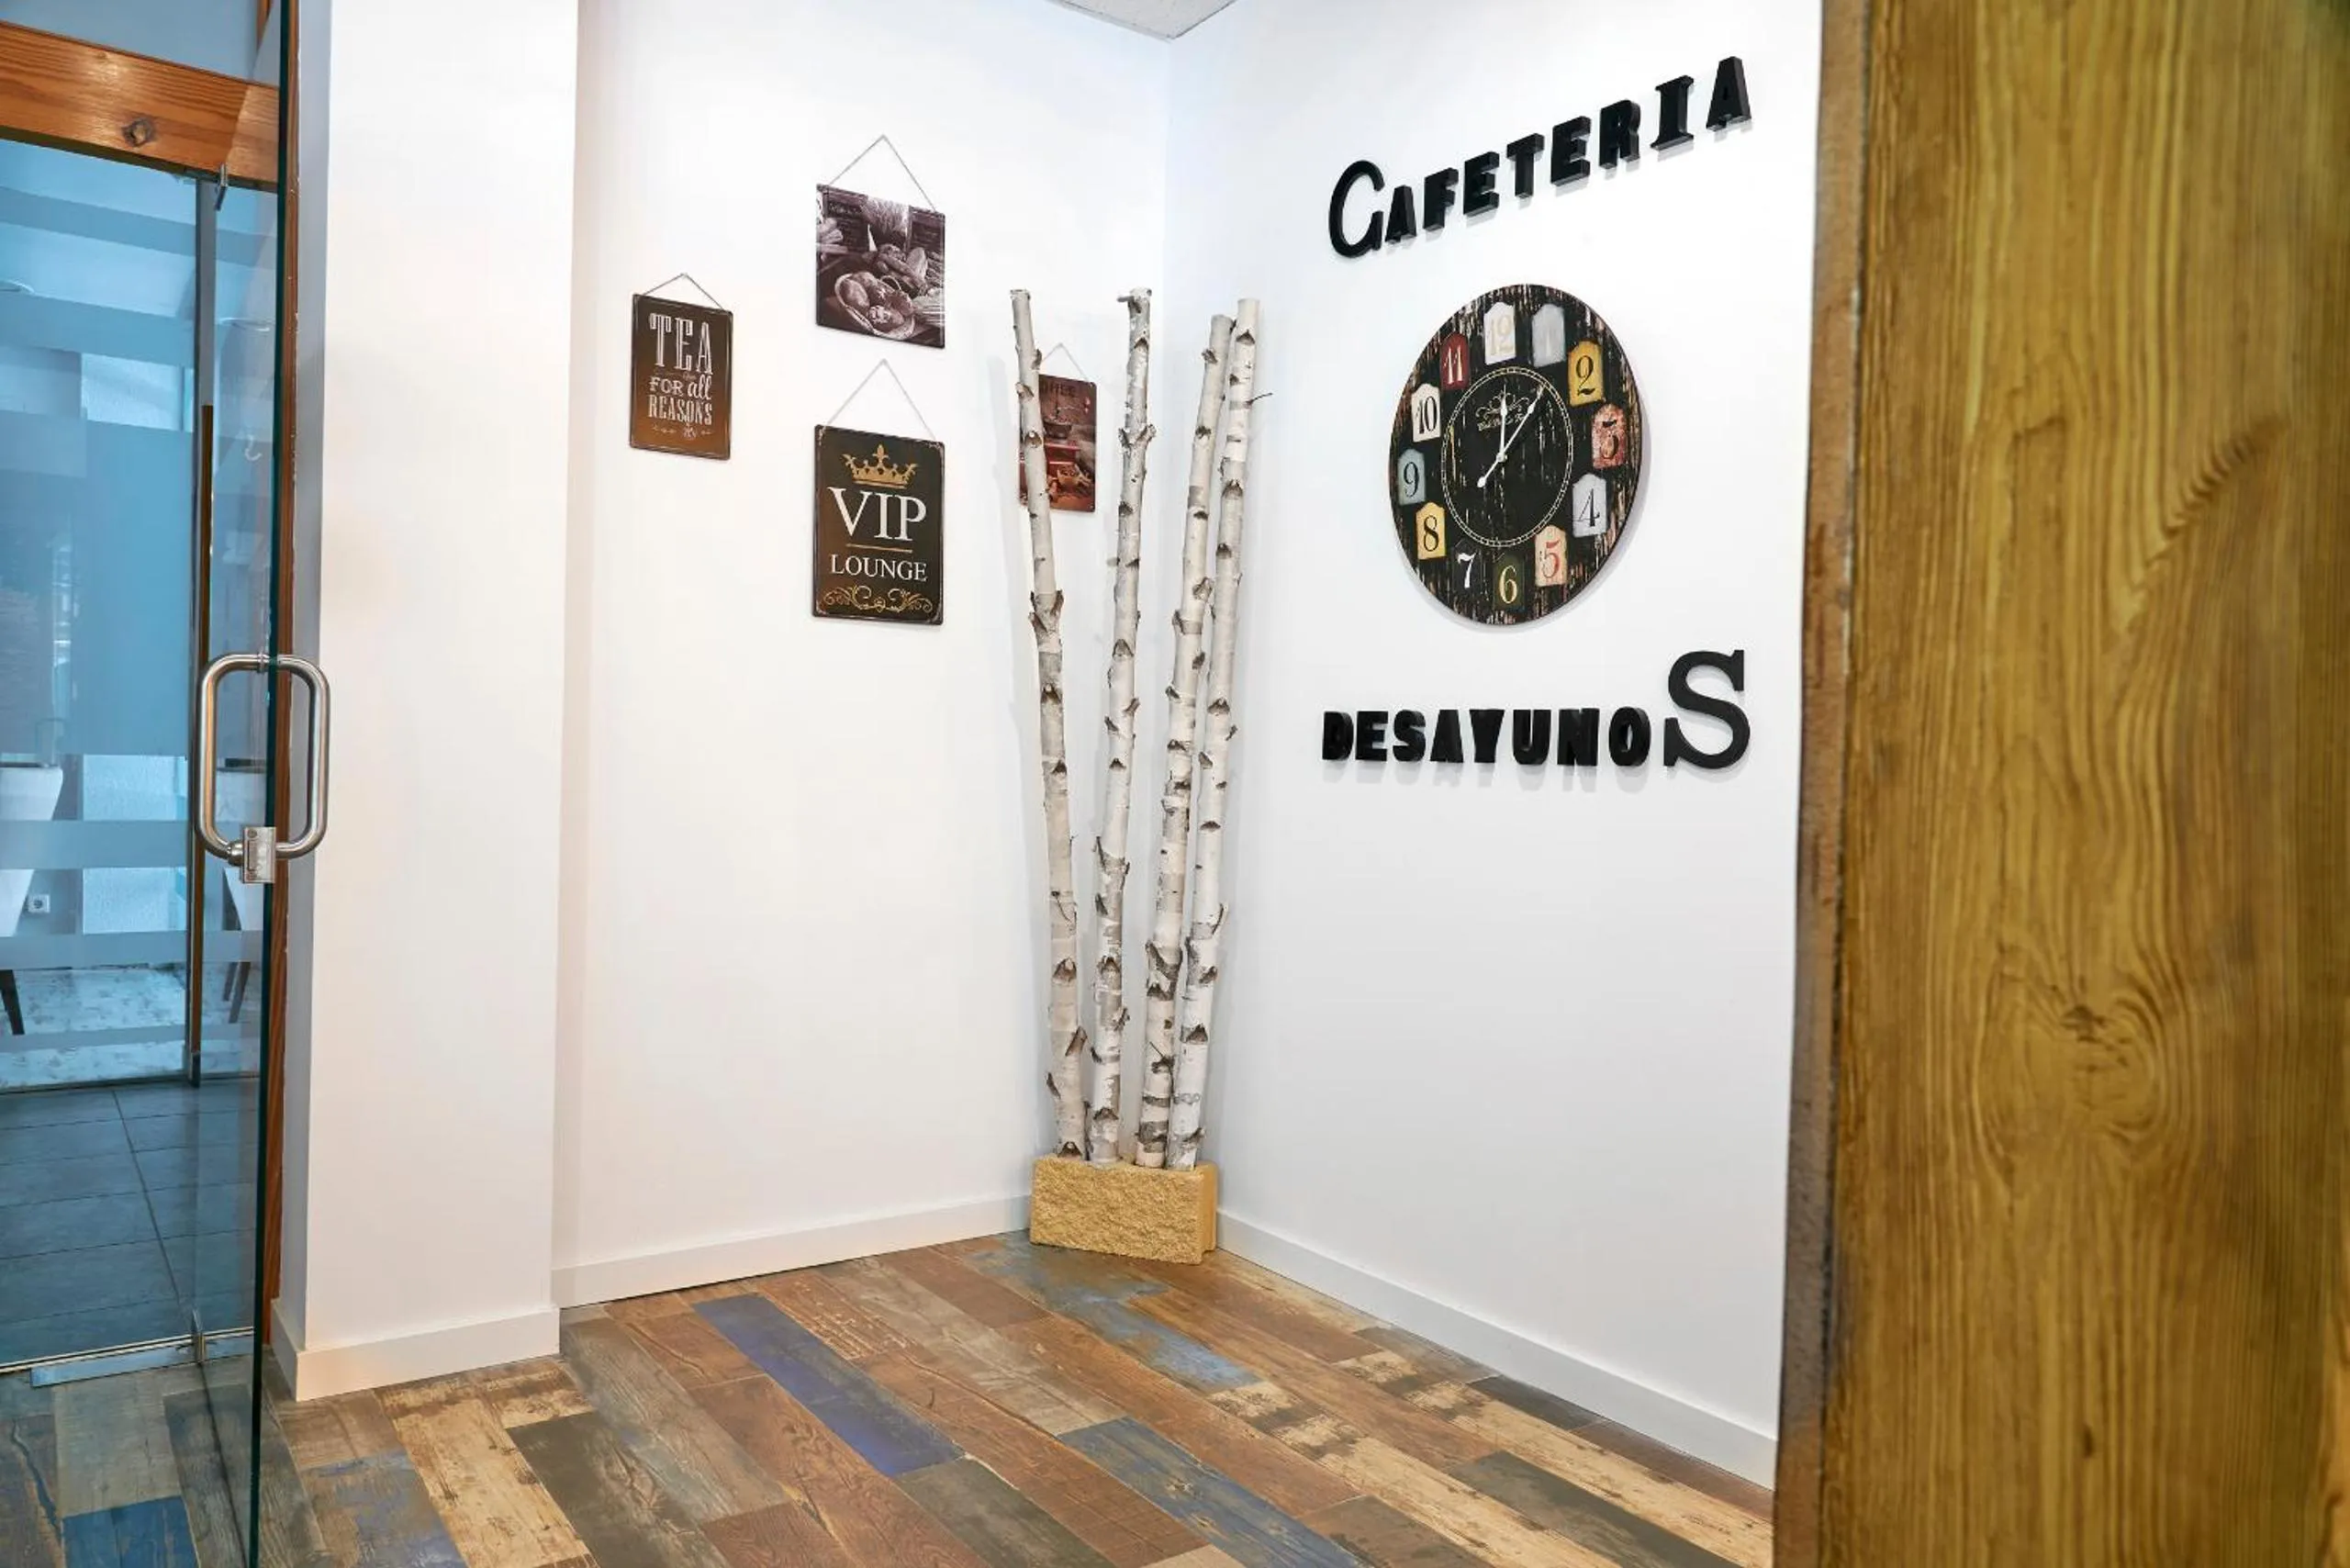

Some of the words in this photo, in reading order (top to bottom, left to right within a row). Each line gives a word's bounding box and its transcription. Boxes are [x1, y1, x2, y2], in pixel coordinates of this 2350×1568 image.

[1328, 55, 1751, 259] CAFETERIA
[648, 312, 713, 375] TEA
[648, 376, 684, 397] FOR
[1443, 349, 1464, 386] 11
[1575, 354, 1595, 397] 2
[648, 394, 713, 426] REASONS
[1416, 395, 1438, 435] 10
[1403, 461, 1419, 498] 9
[827, 486, 927, 542] VIP
[1573, 487, 1600, 528] 4
[1422, 514, 1440, 553] 8
[831, 554, 928, 582] LOUNGE
[1457, 552, 1475, 588] 7
[1542, 539, 1561, 579] 5
[1499, 565, 1517, 605] 6
[1322, 649, 1751, 769] DESAYUNOS
